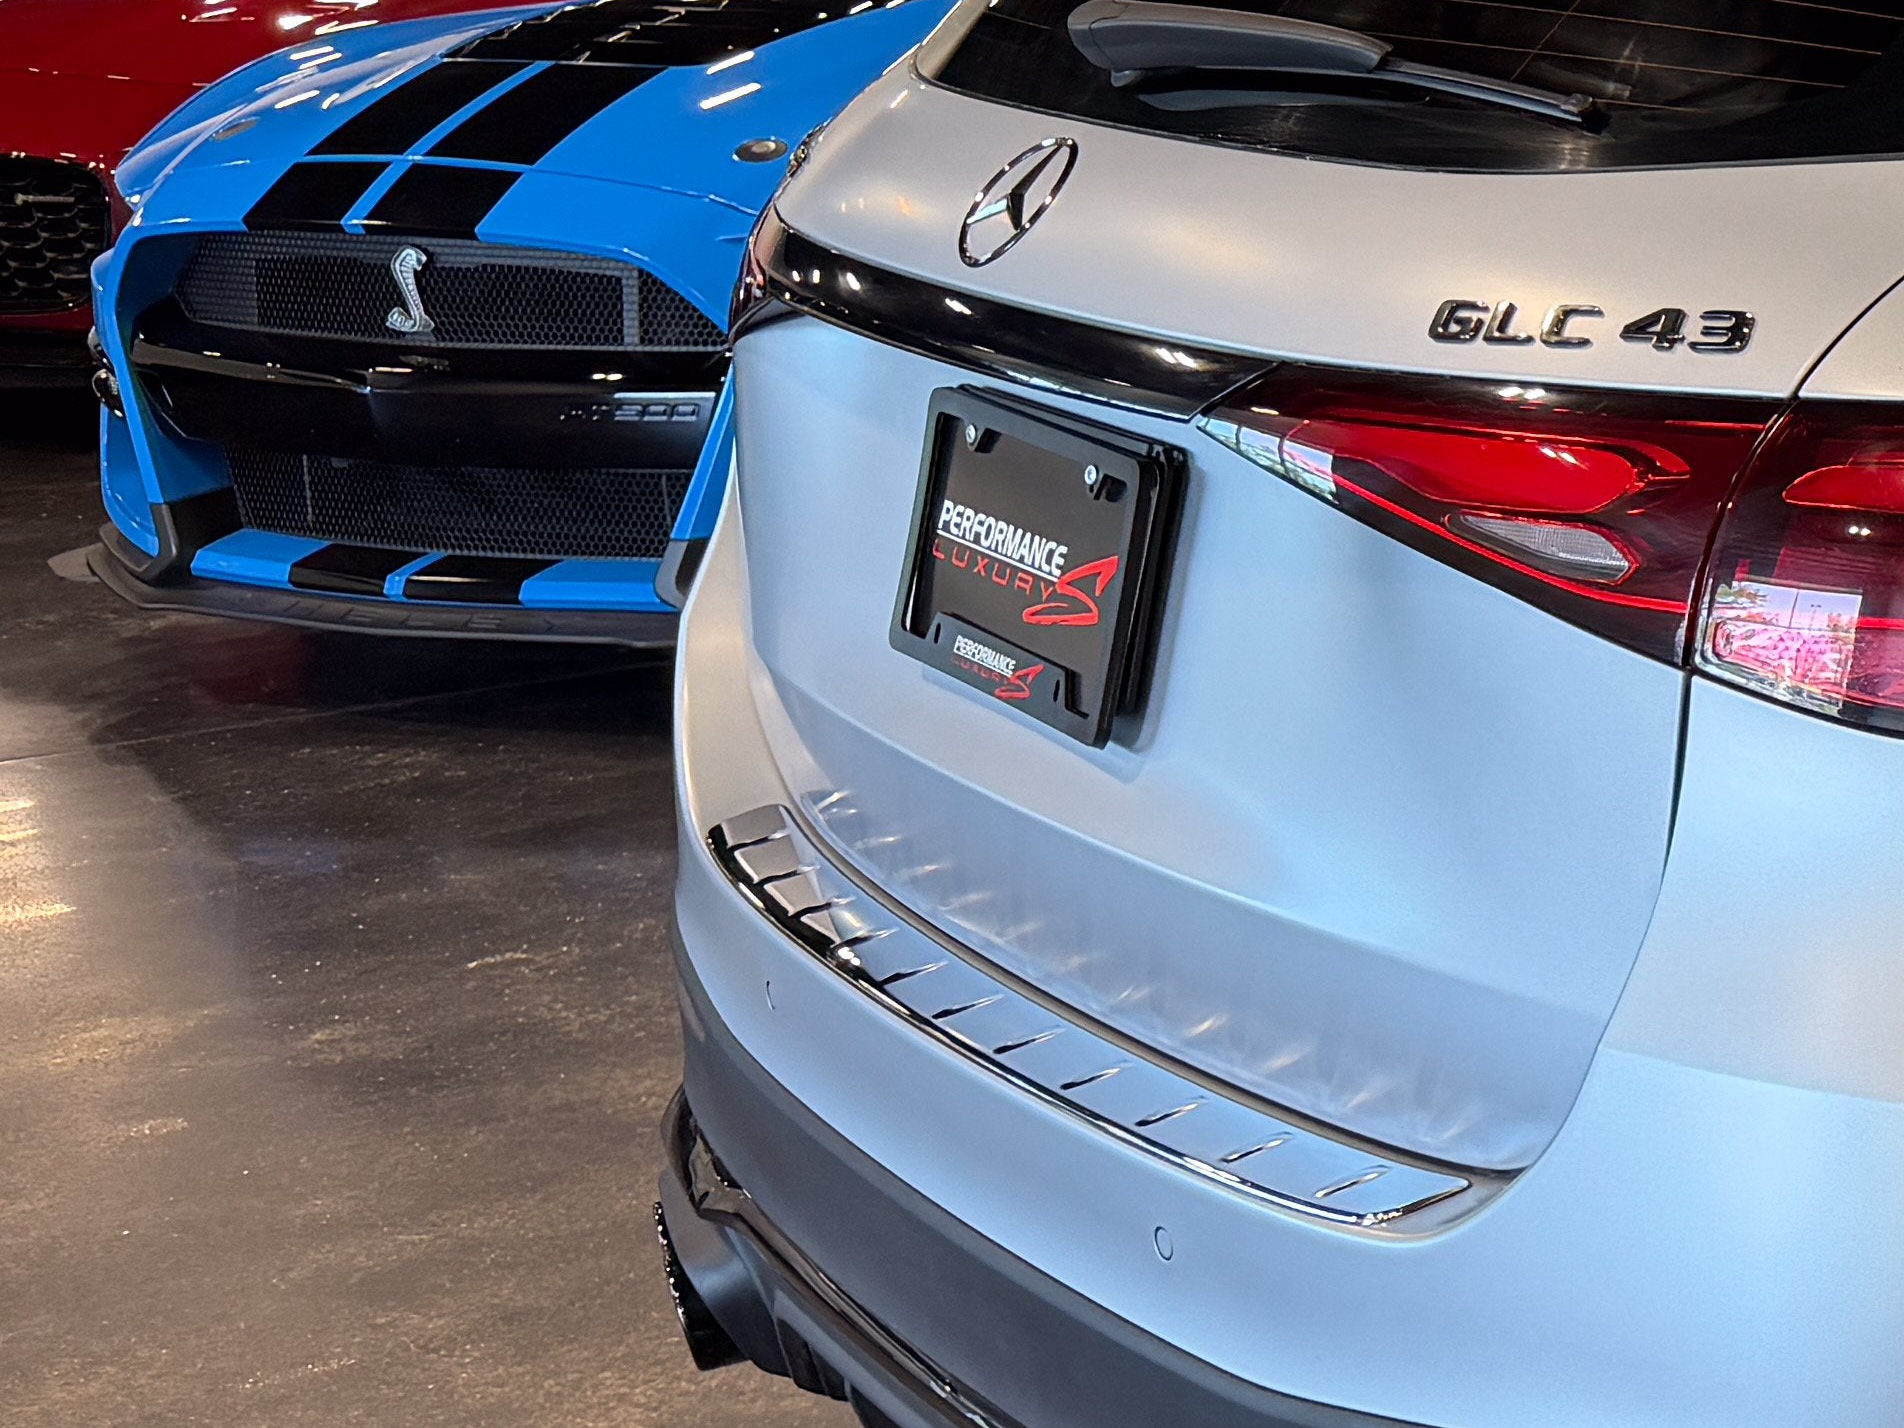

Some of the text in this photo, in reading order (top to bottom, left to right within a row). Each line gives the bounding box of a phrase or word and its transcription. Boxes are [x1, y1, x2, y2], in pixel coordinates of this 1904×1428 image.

[1427, 298, 1756, 354] GLC 43
[937, 498, 1069, 578] PERFORMANCE
[932, 538, 1055, 603] LUXURY
[954, 634, 1017, 674] PERFORMANCE
